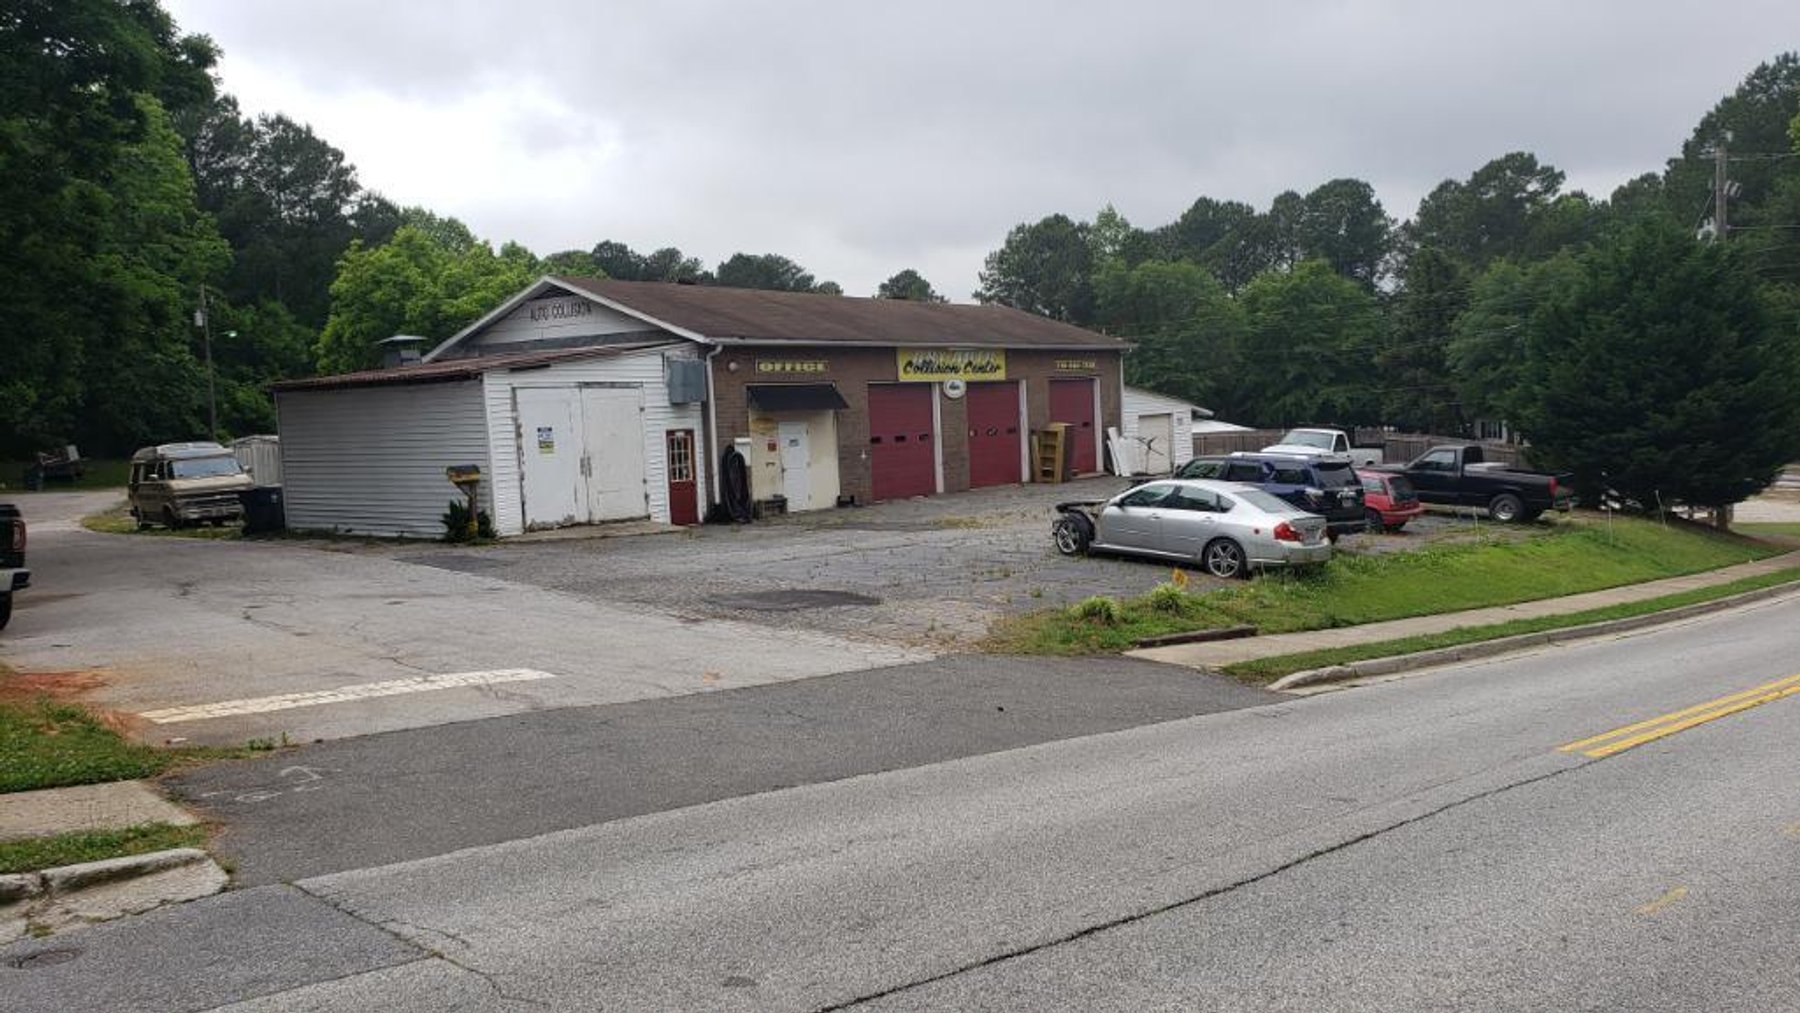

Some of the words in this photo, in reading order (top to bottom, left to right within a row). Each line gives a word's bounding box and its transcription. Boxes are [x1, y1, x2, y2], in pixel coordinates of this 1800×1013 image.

[530, 307, 548, 321] AUTO
[551, 302, 592, 319] COLLISION
[758, 361, 826, 372] OFFICE
[903, 360, 961, 375] Collision
[962, 360, 1002, 374] Center
